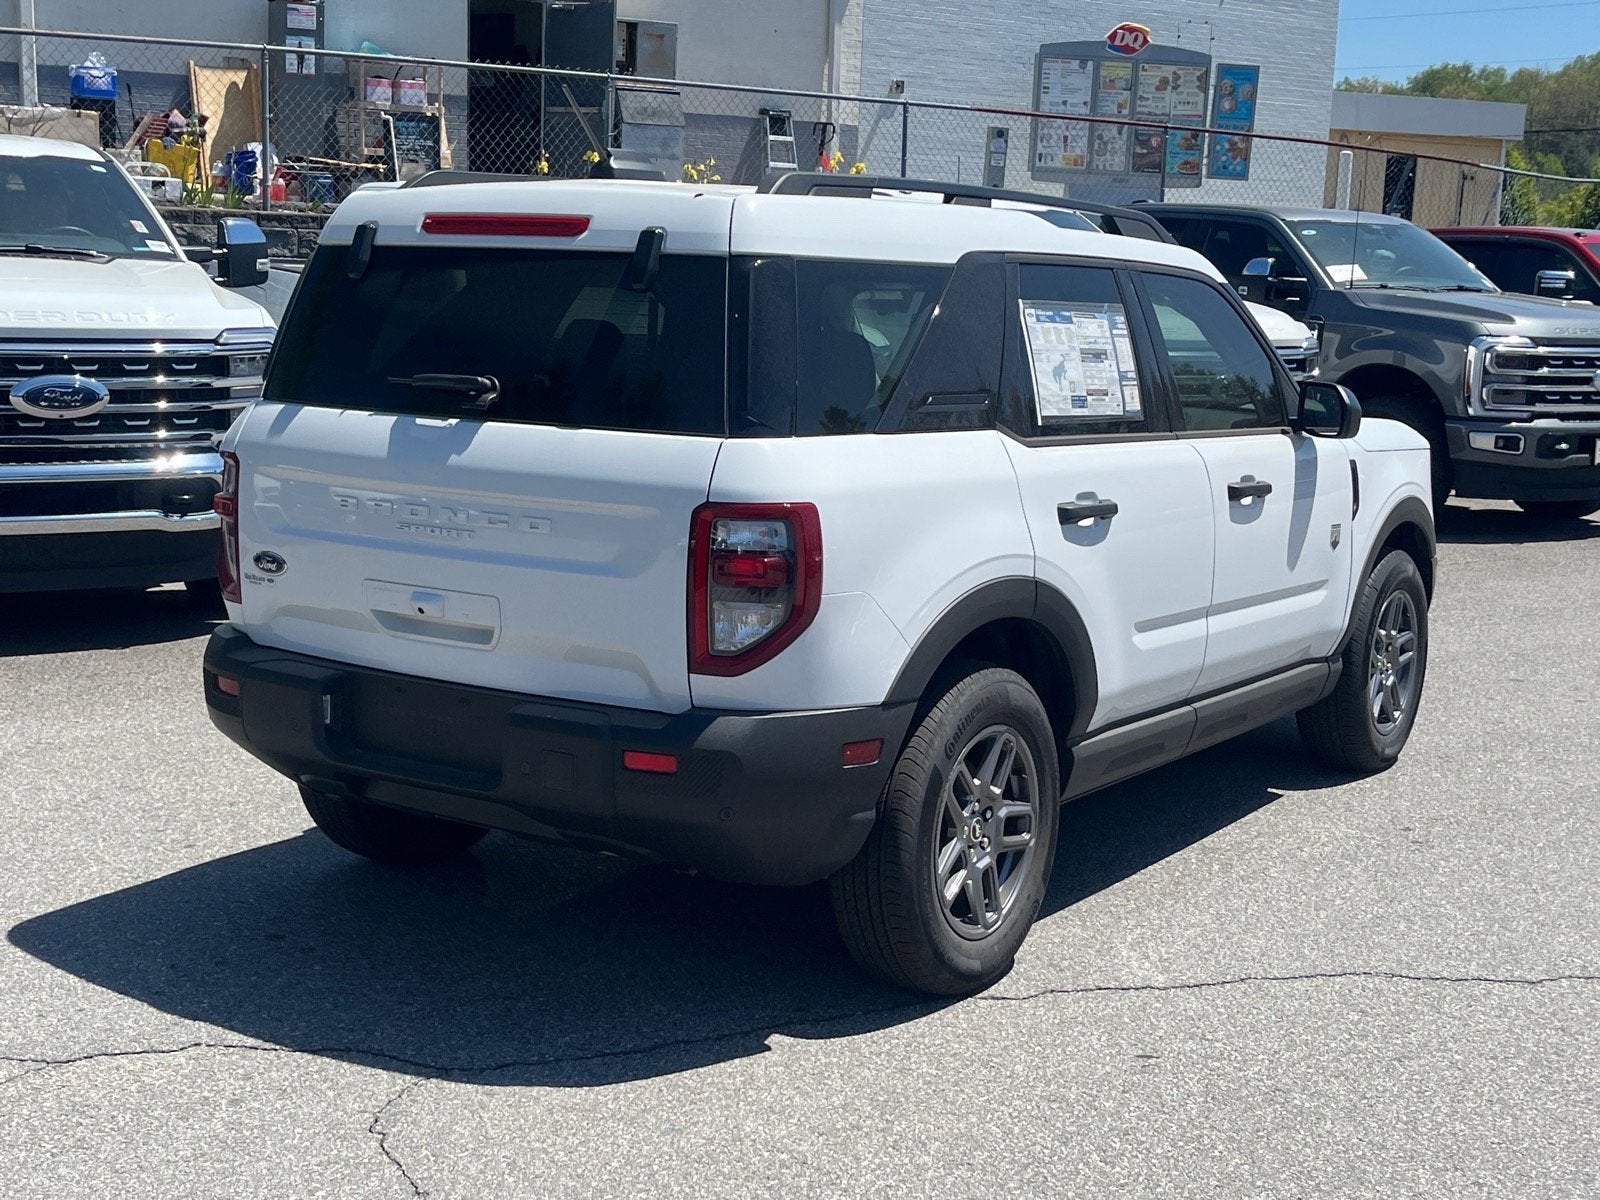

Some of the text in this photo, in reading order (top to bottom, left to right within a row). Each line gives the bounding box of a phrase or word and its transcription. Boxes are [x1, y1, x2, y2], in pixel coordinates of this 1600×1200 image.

[1113, 29, 1145, 50] DQ
[76, 310, 177, 325] DUTY
[335, 495, 552, 533] BRONCO
[396, 521, 476, 539] SPORT
